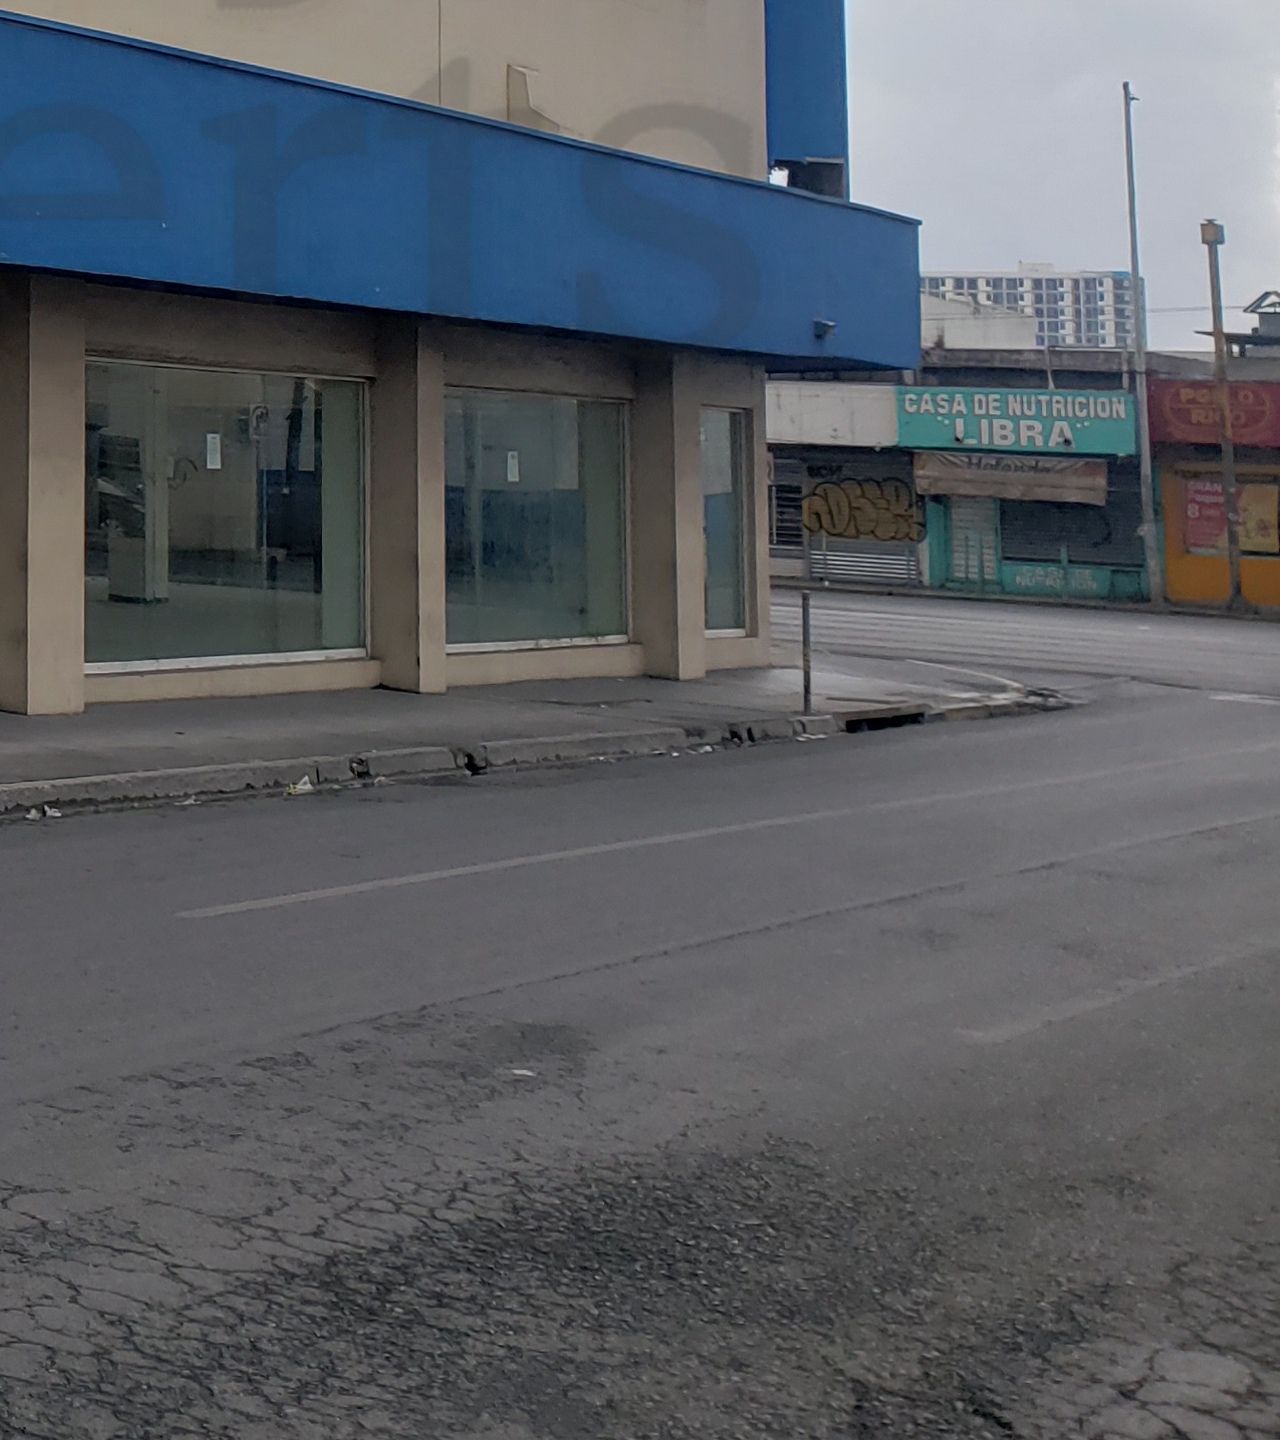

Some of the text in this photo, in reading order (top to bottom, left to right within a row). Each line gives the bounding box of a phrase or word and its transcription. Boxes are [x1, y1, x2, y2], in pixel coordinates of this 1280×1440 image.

[905, 393, 1127, 419] CASA DE NUTRICION
